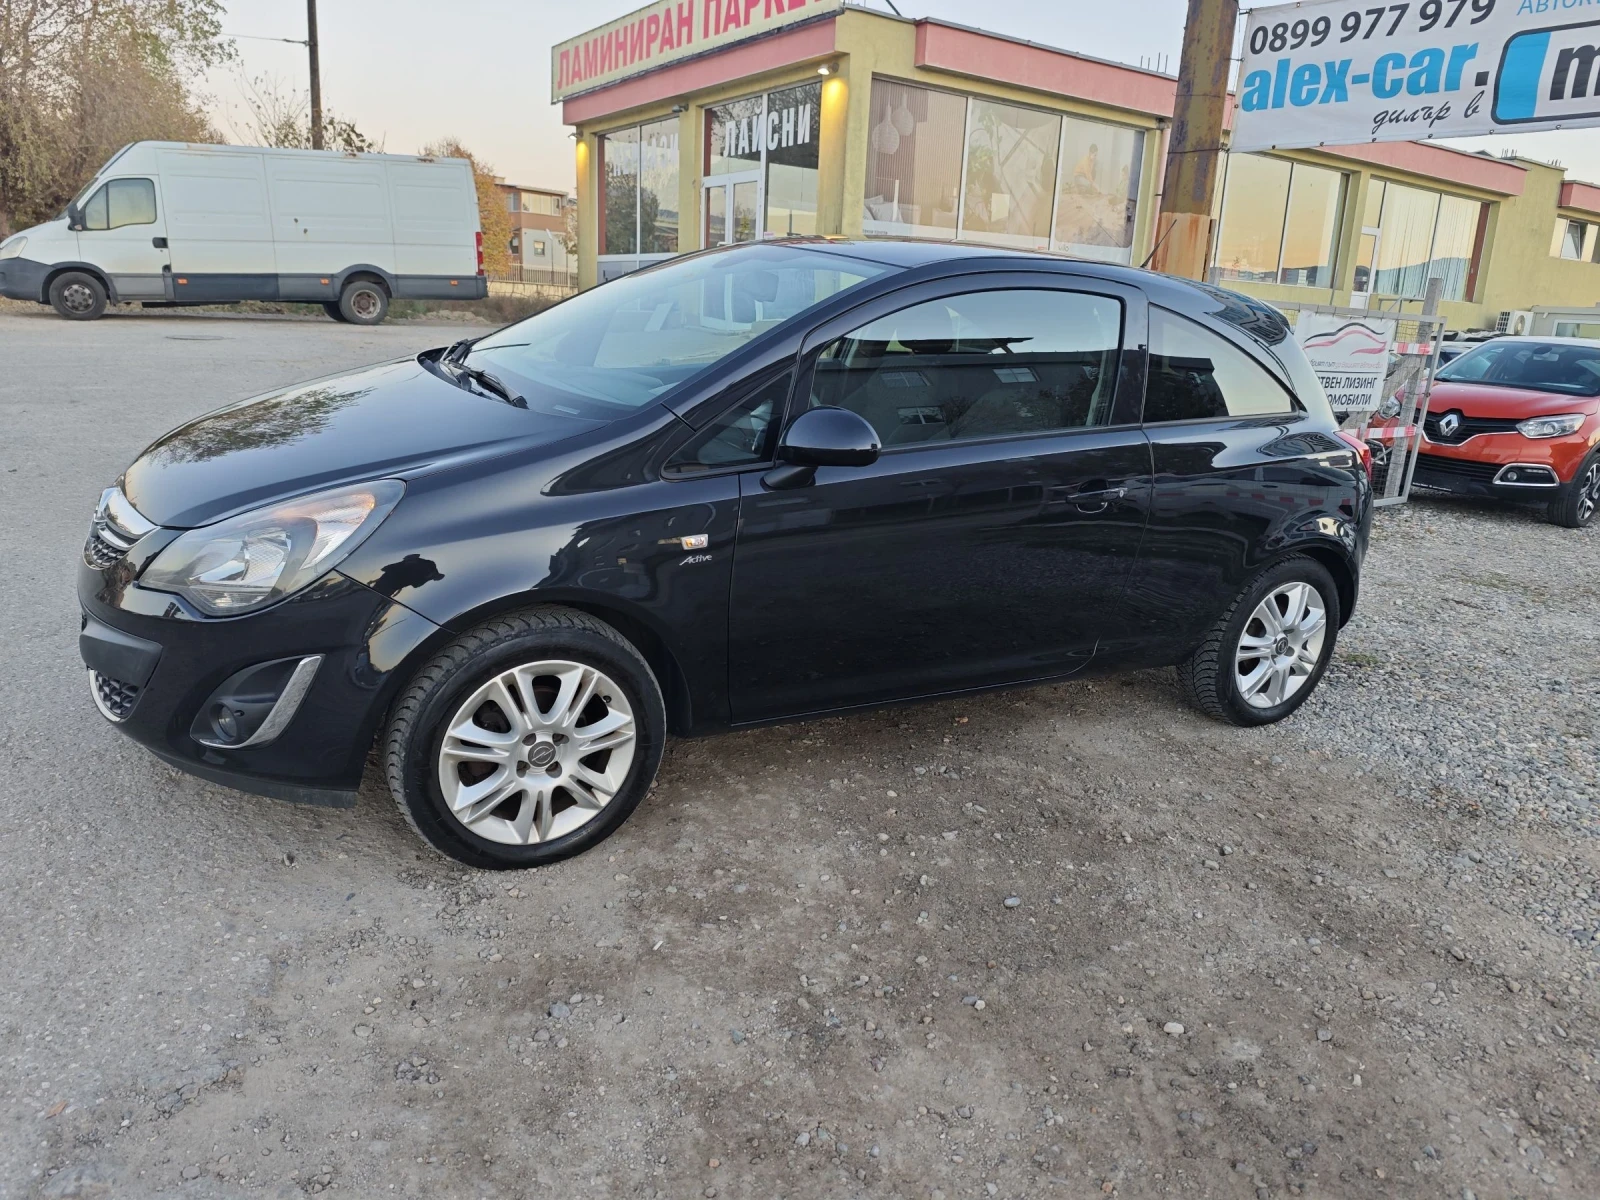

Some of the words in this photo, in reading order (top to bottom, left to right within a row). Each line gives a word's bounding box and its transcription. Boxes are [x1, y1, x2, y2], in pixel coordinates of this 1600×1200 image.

[1250, 16, 1331, 55] 0899
[1340, 4, 1410, 43] 977
[1419, 0, 1494, 33] 979
[557, 0, 693, 90] ЛАМИНИРАН
[703, 0, 822, 39] ПАР
[723, 103, 811, 158] ЛАЙСНИ
[1372, 101, 1451, 134] дилър
[1318, 377, 1342, 389] ТВЕН
[1342, 377, 1378, 389] ЛИЗИНГ
[1327, 394, 1372, 406] ОМОБИЛИ
[679, 554, 713, 566] Active
